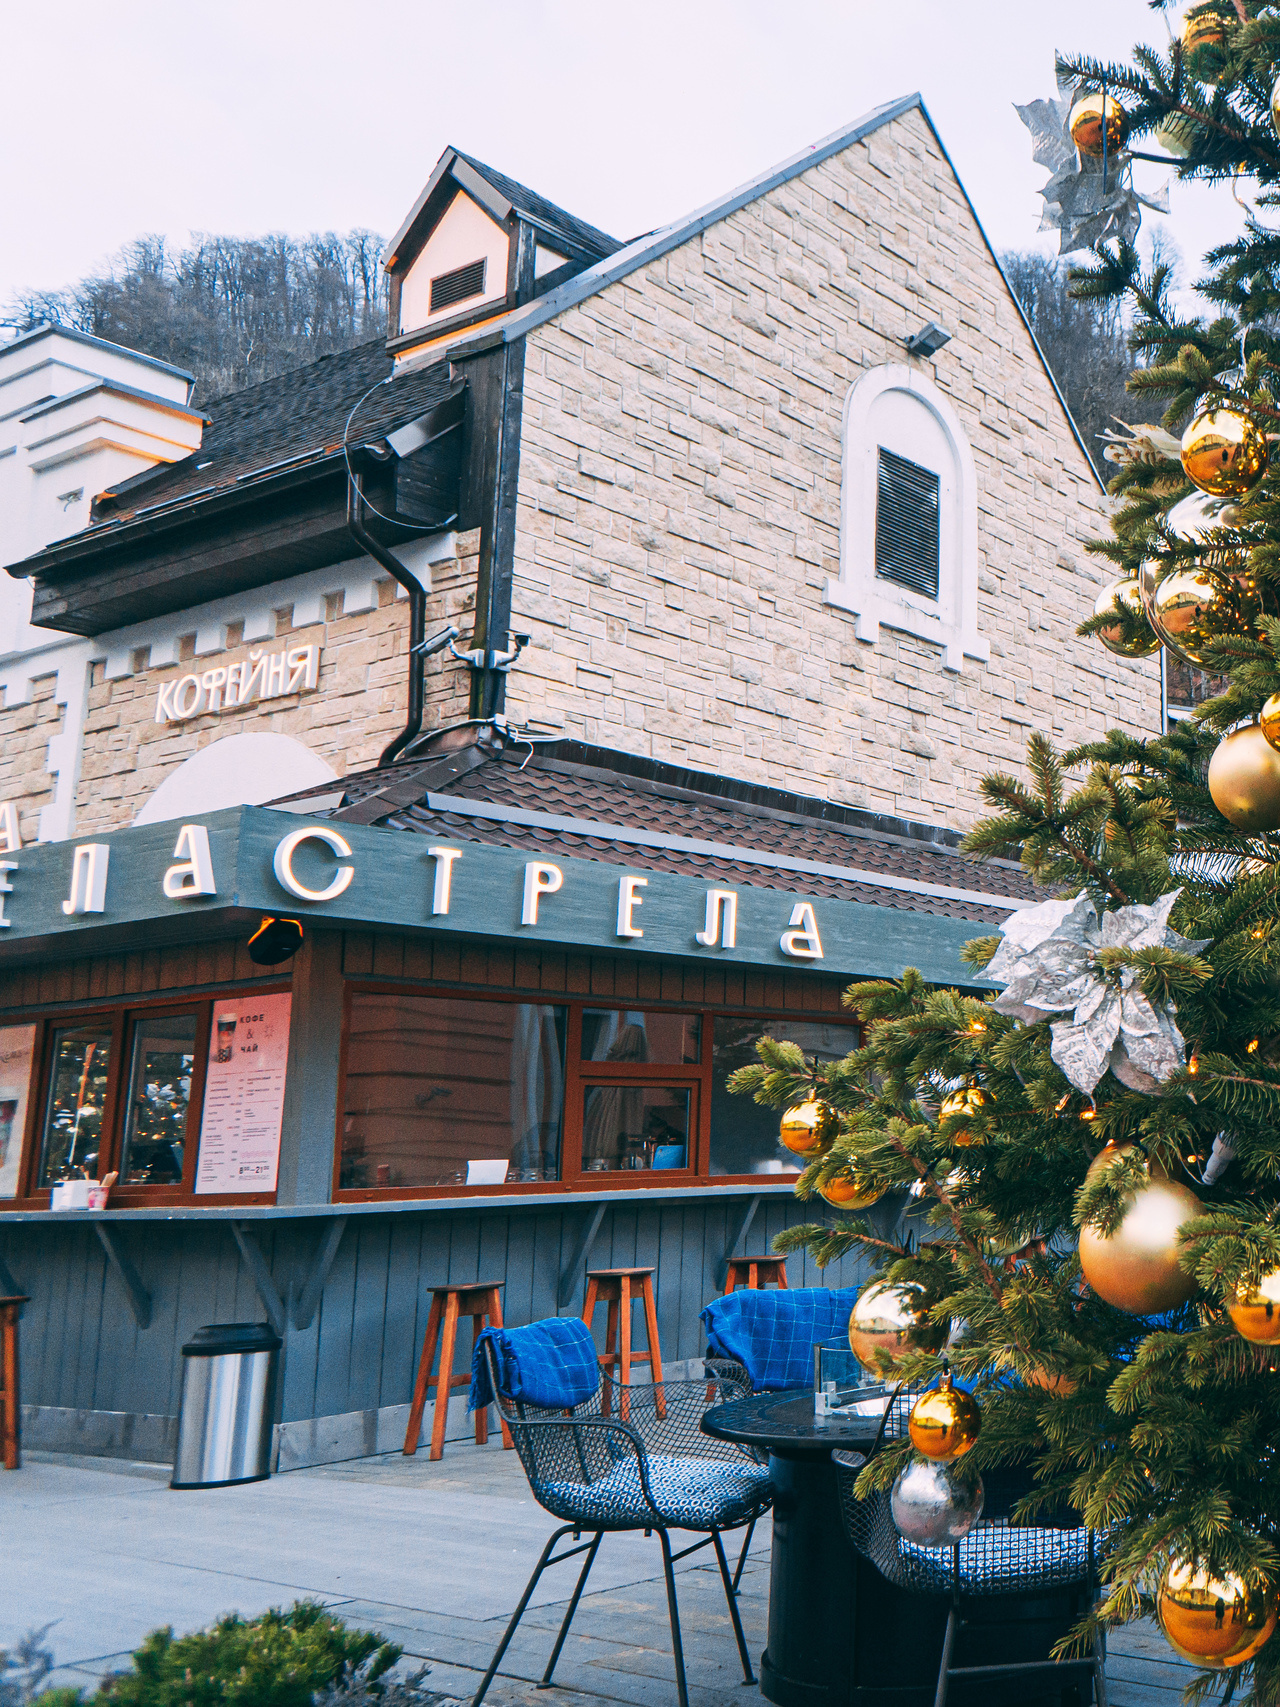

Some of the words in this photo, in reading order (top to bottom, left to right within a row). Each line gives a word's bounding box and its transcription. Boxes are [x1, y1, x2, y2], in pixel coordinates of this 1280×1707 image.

[154, 644, 320, 724] КОФЕЙНЯ
[273, 826, 825, 960] СТРЕЛА
[240, 1013, 265, 1023] КОФЕ
[241, 1043, 258, 1052] ЧАЙ
